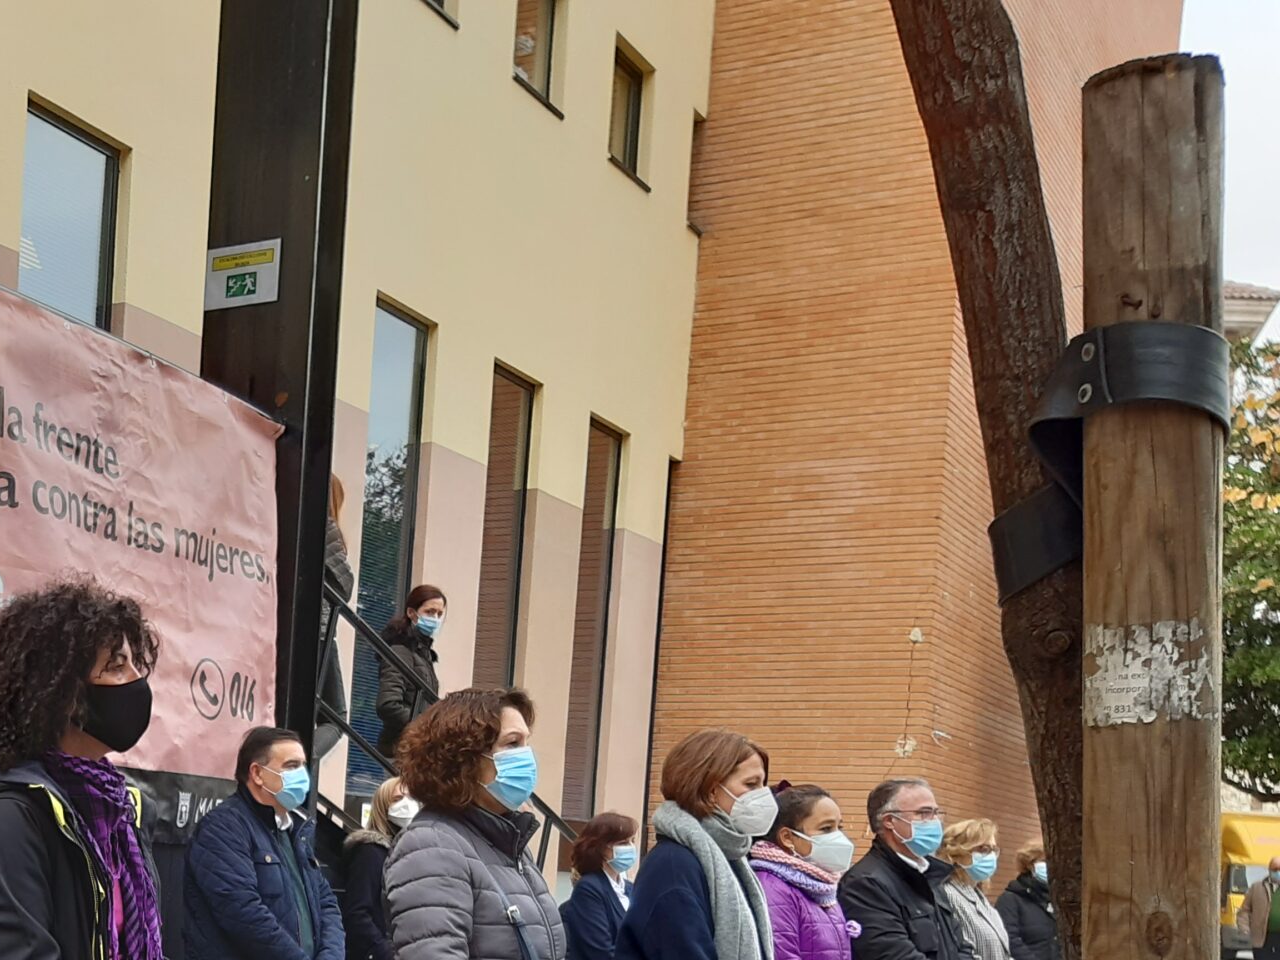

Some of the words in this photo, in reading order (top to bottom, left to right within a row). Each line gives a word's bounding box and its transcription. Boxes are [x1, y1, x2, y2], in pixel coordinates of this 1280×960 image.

[32, 402, 120, 479] frente
[31, 480, 118, 542] contra
[127, 501, 166, 554] las
[173, 528, 271, 584] mujeres.
[229, 671, 257, 722] 016
[1114, 704, 1132, 714] 831
